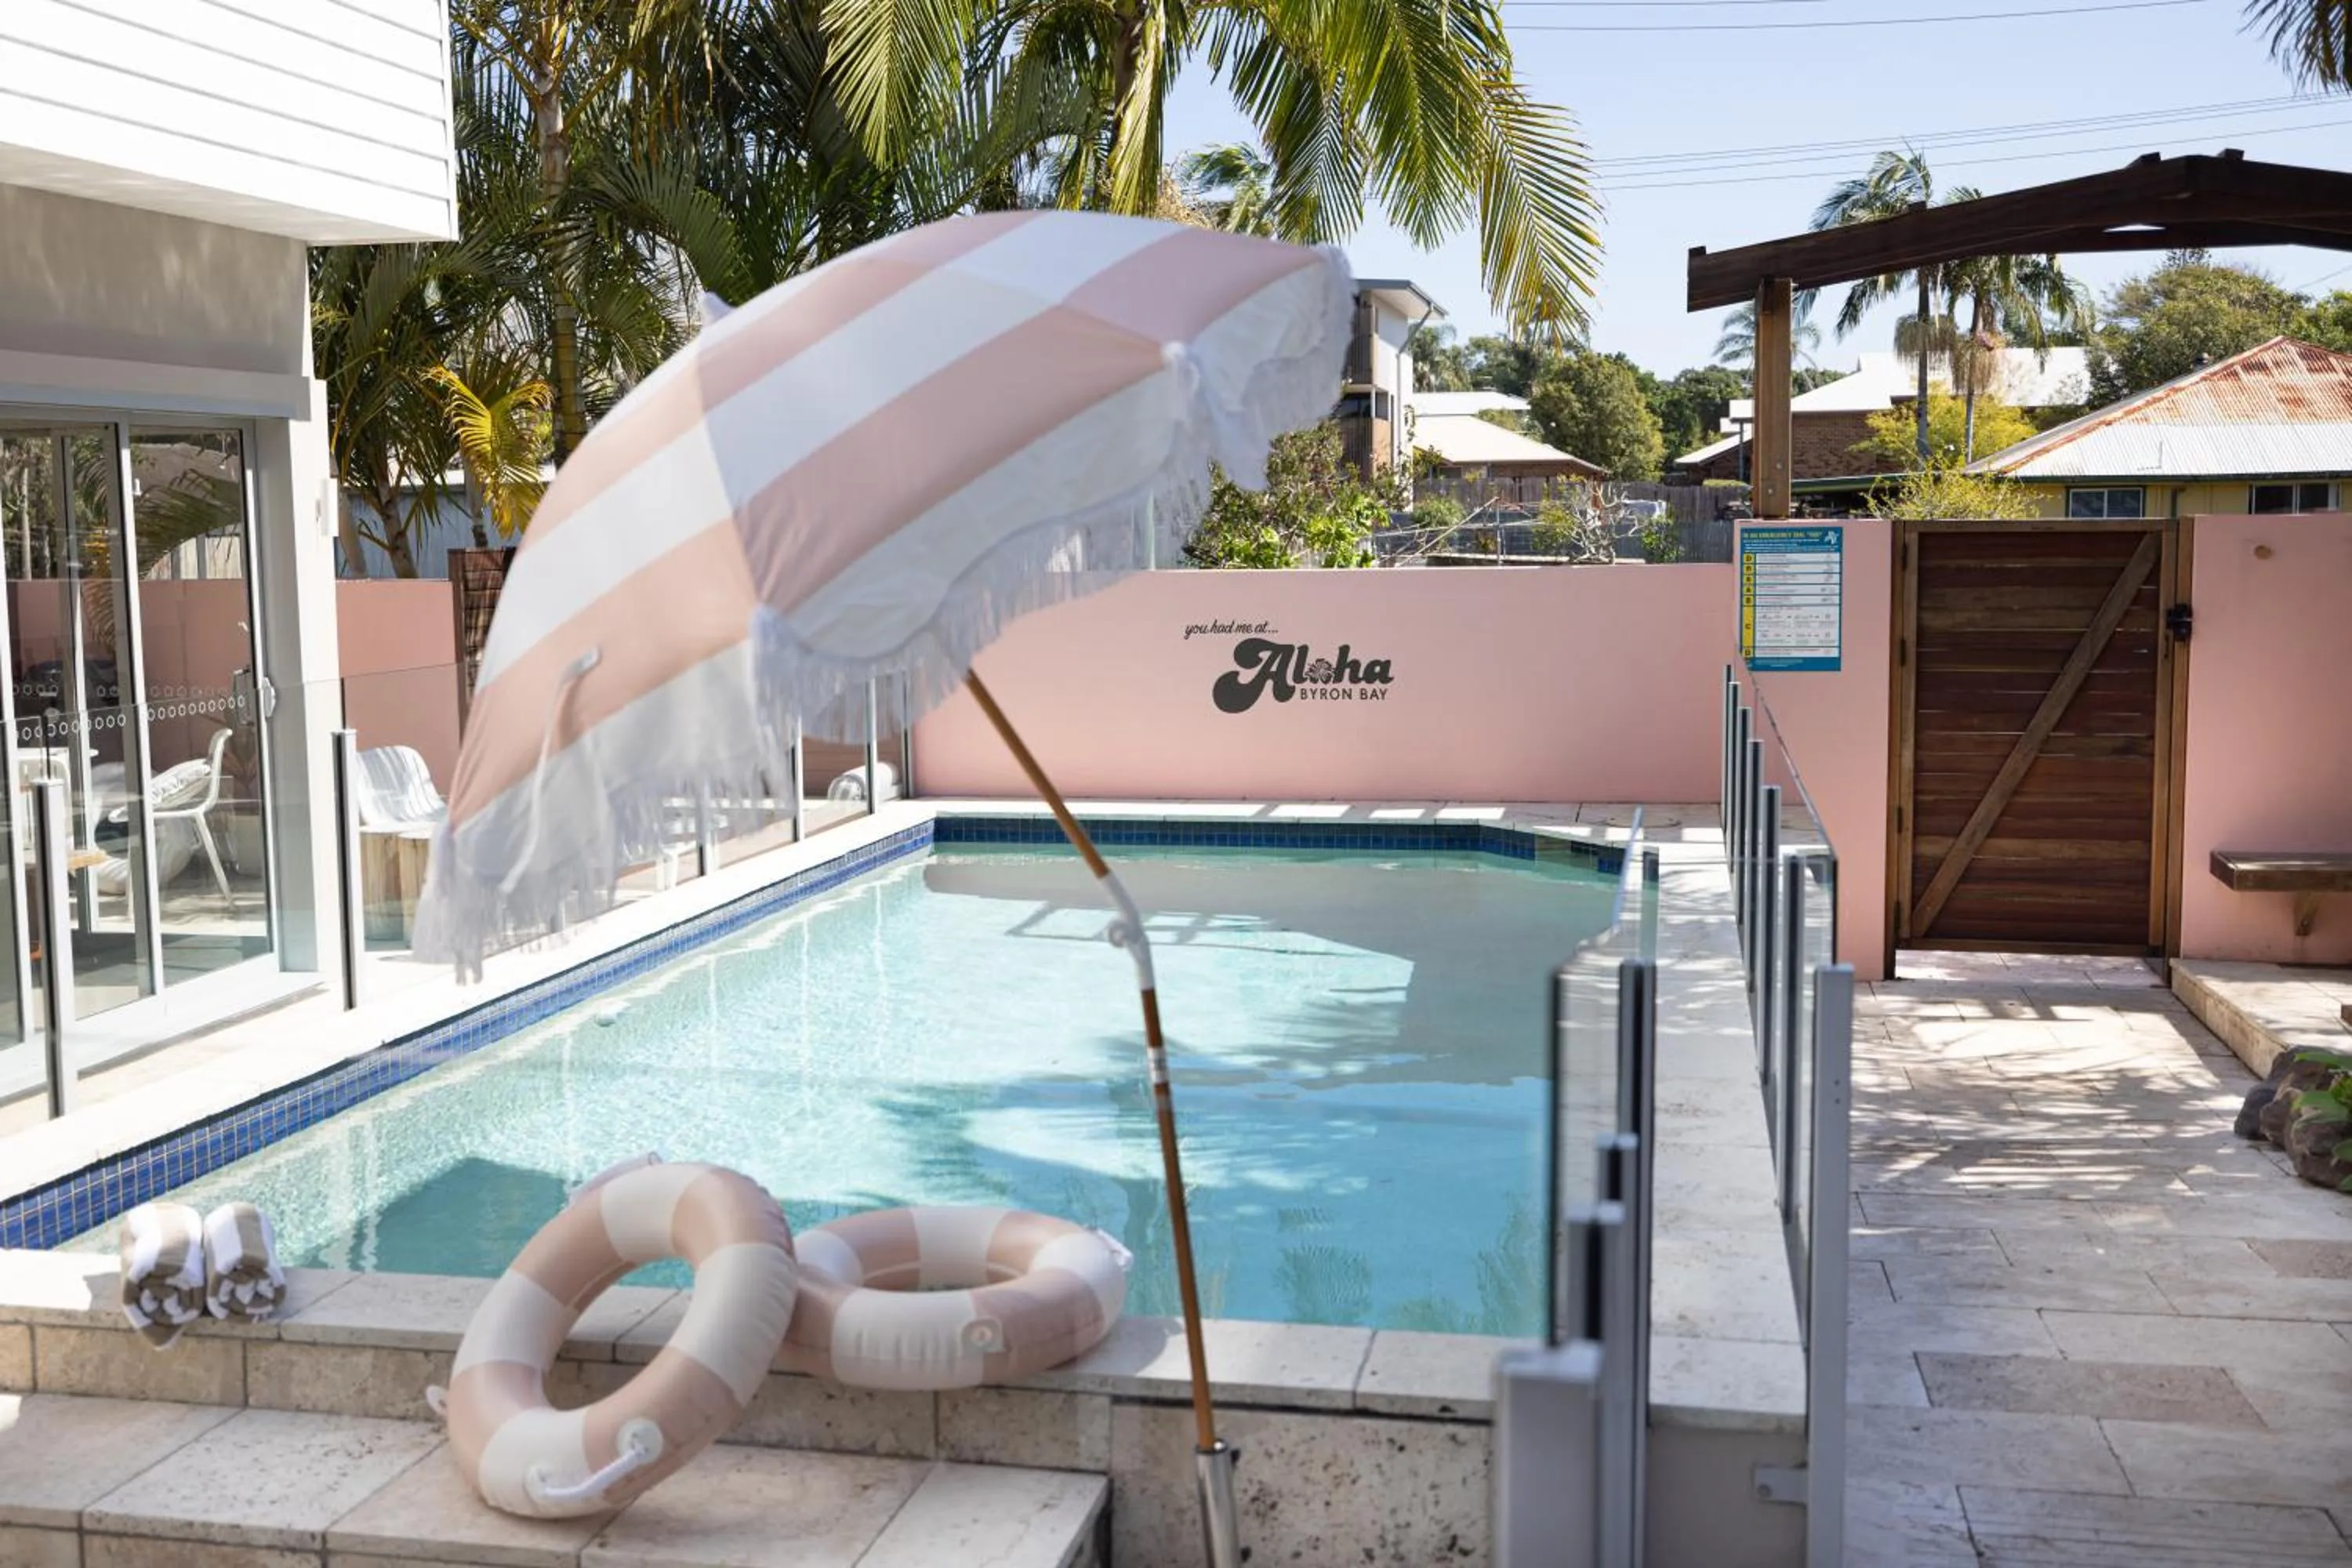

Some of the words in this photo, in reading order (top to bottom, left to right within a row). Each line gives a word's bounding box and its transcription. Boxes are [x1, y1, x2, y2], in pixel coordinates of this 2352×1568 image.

[1184, 624, 1210, 640] you
[1210, 619, 1235, 633] had
[1236, 622, 1253, 633] me
[1213, 637, 1394, 713] Aloha
[1300, 688, 1352, 700] BYRON
[1359, 688, 1388, 700] BAY
